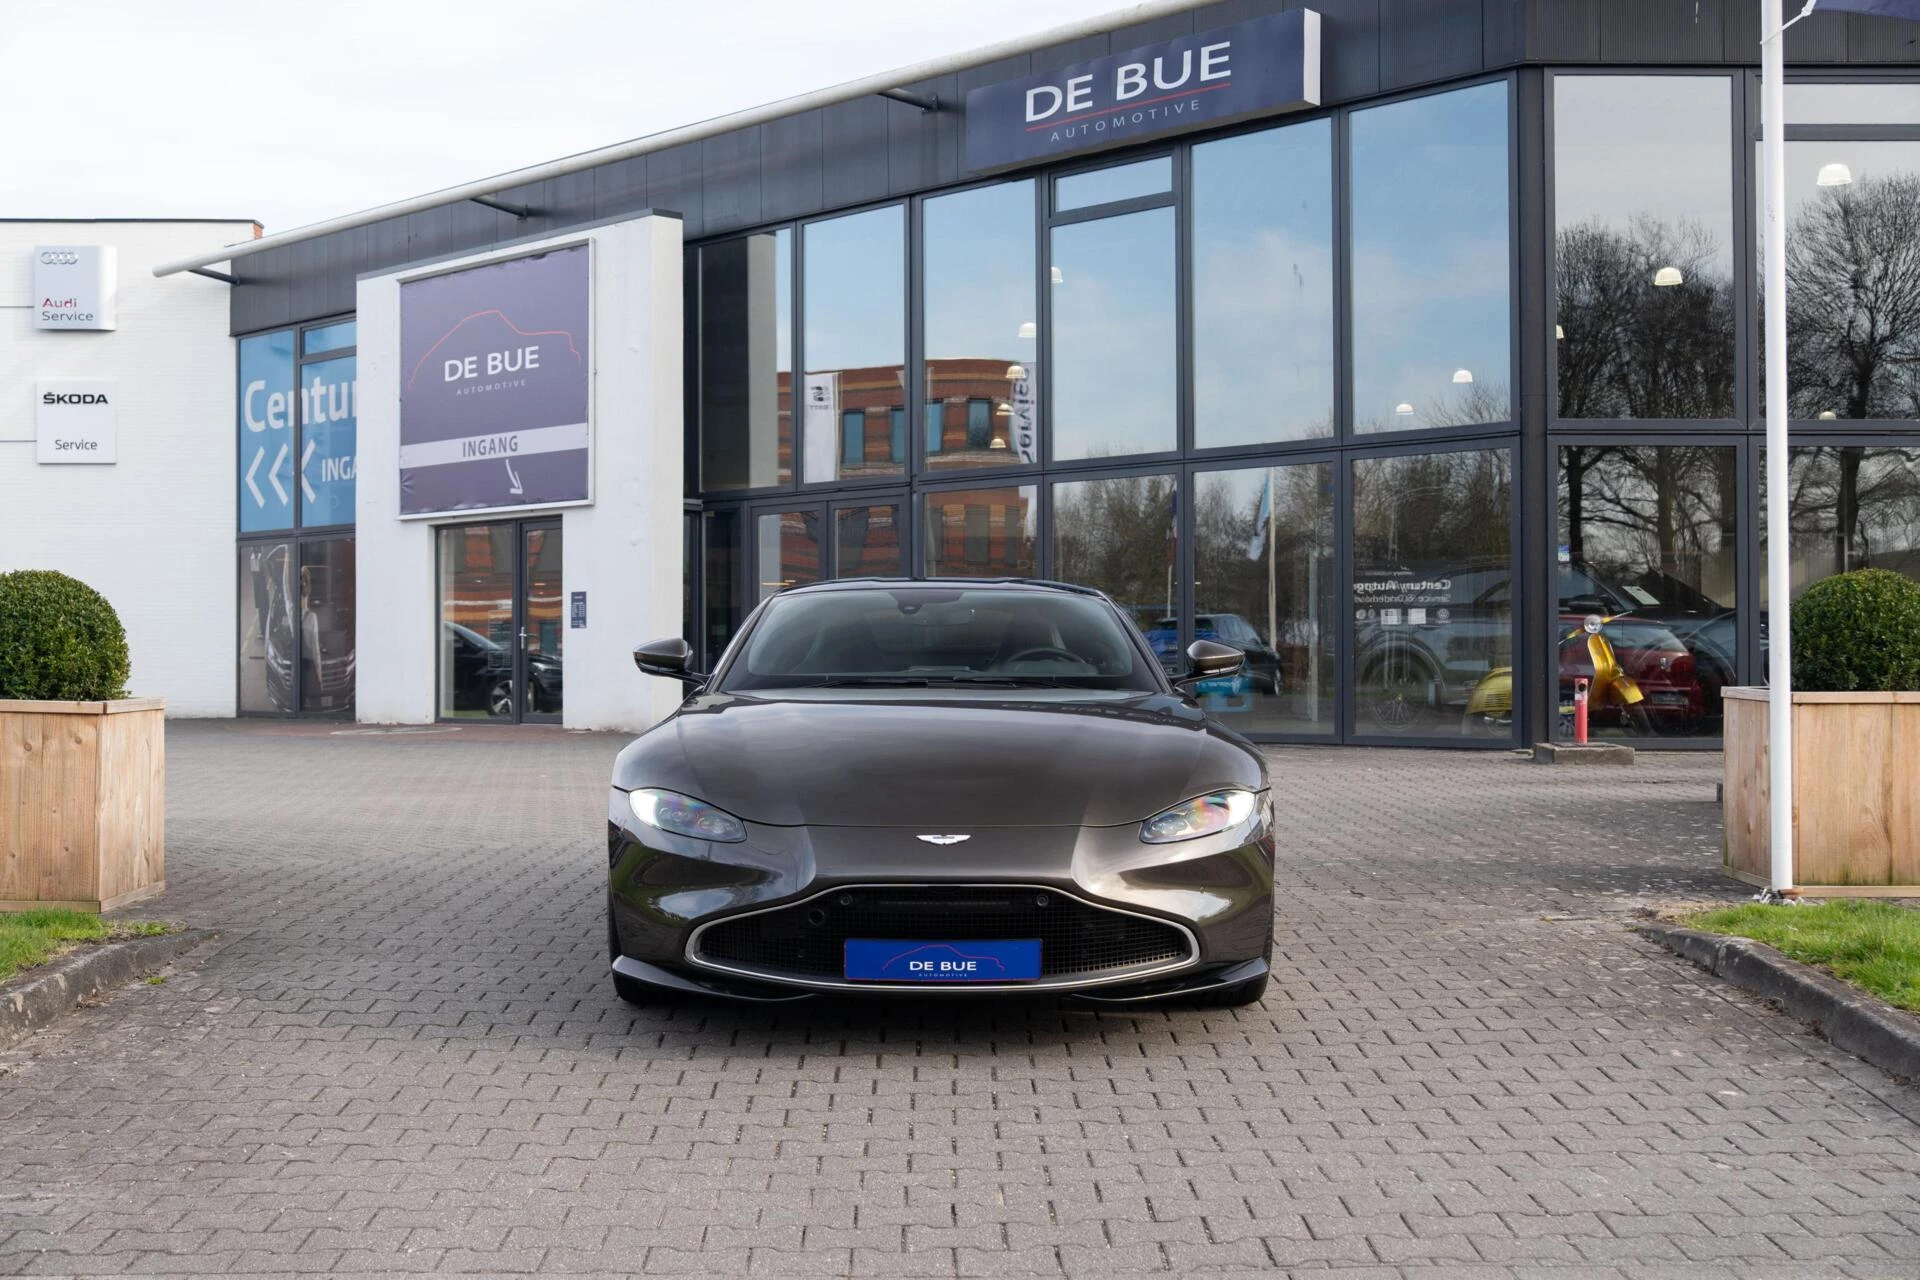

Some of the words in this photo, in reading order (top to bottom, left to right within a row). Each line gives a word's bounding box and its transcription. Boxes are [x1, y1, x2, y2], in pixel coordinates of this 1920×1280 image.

[1025, 74, 1094, 123] DE
[1115, 41, 1232, 101] BUE
[1050, 100, 1201, 143] AUTOMOTIVE
[42, 298, 78, 308] Audi
[41, 310, 94, 321] Service
[444, 355, 478, 382] DE
[487, 346, 540, 375] BUE
[456, 379, 527, 396] AUTOMOTIVE
[42, 392, 109, 405] ŠKODA
[54, 439, 98, 450] Service
[462, 435, 519, 458] INGANG
[909, 961, 934, 971] DE
[940, 961, 977, 971] BUE
